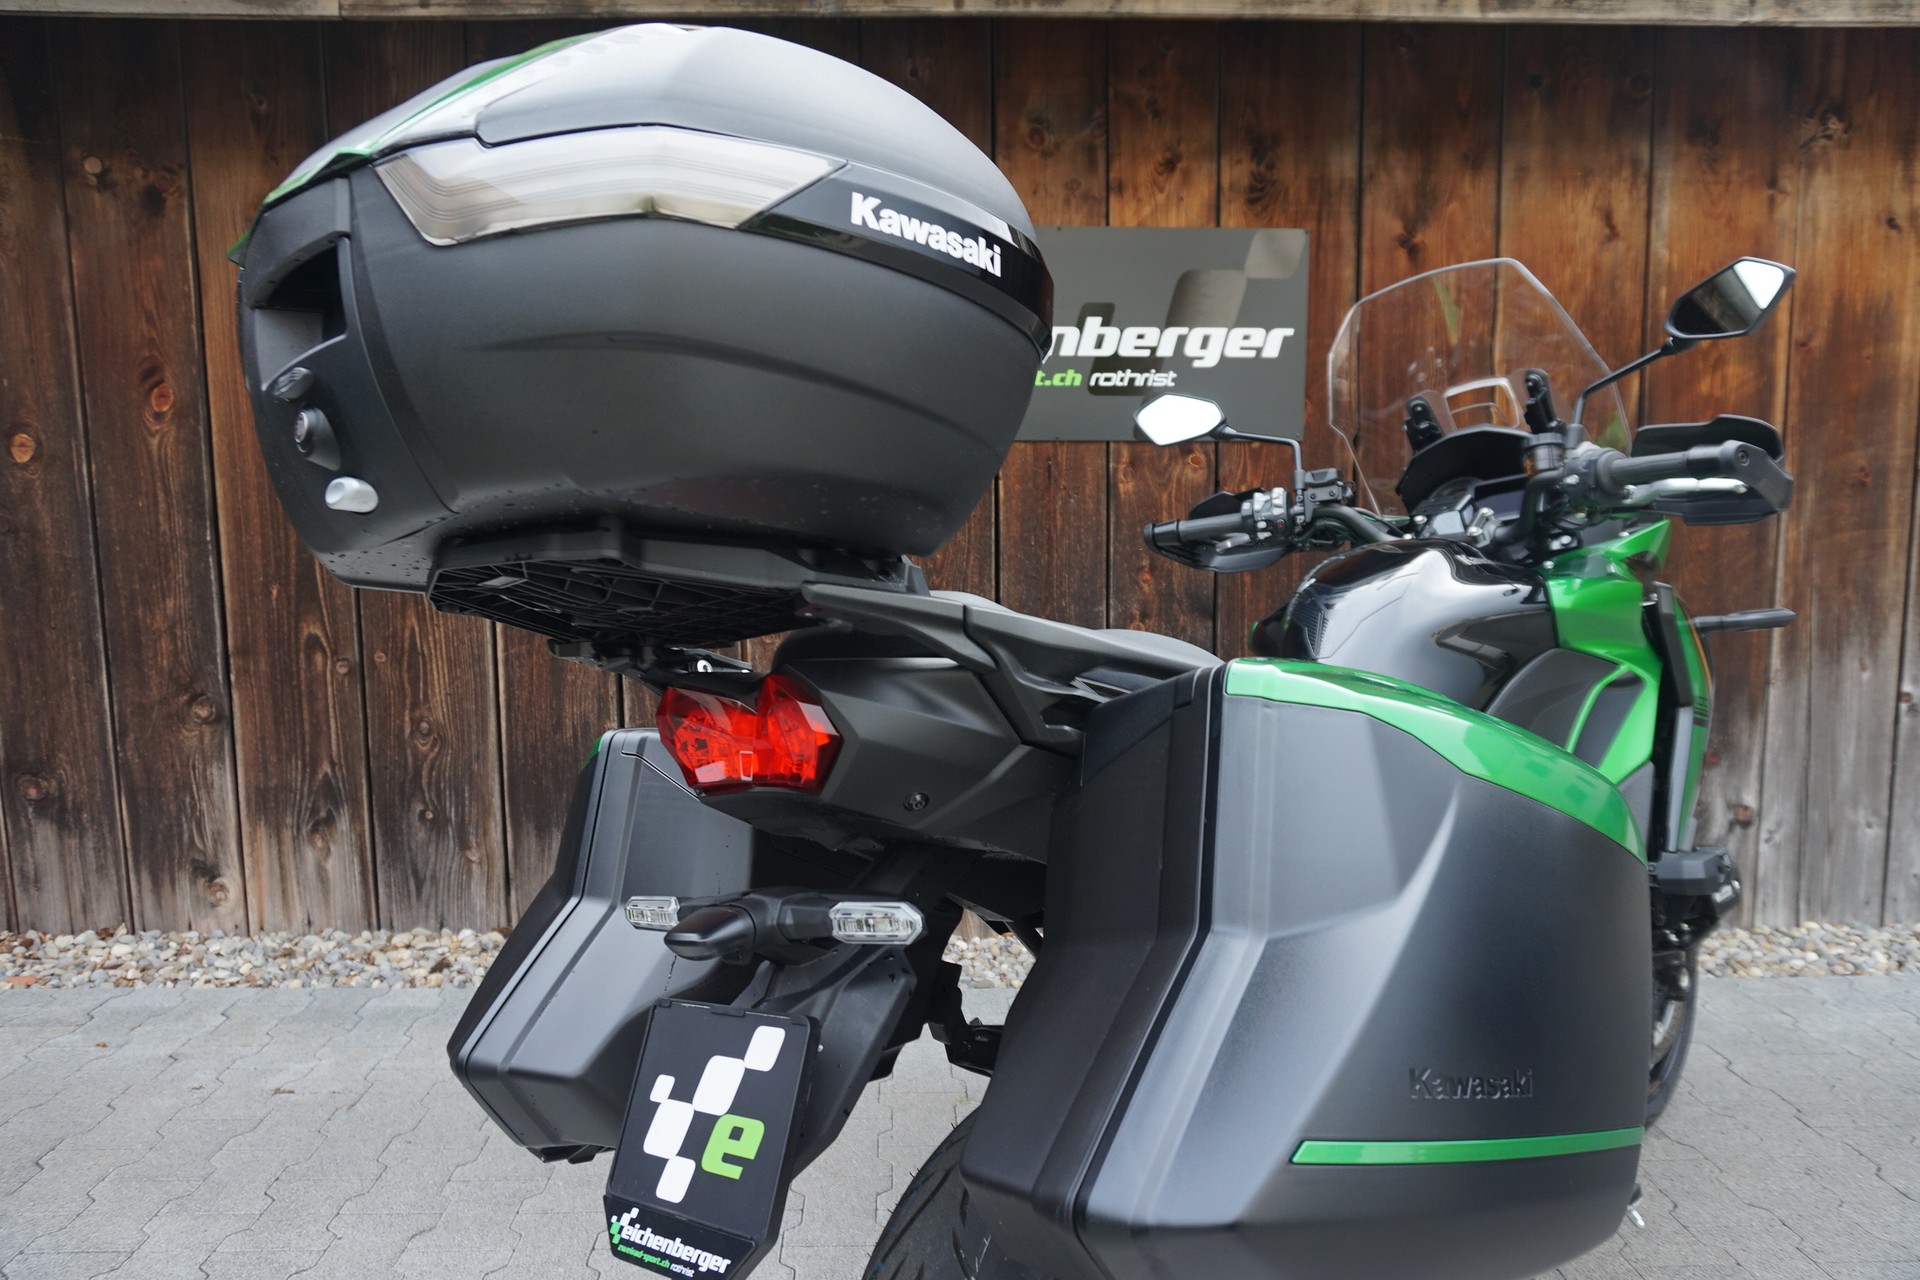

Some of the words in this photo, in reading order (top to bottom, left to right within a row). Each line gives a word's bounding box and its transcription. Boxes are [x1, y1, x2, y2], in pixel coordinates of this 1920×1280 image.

[850, 191, 1002, 278] Kawasaki
[1089, 369, 1178, 387] rothrist
[1408, 1068, 1533, 1100] Kawasaki
[701, 1113, 766, 1181] e
[620, 1223, 732, 1274] eichenberger
